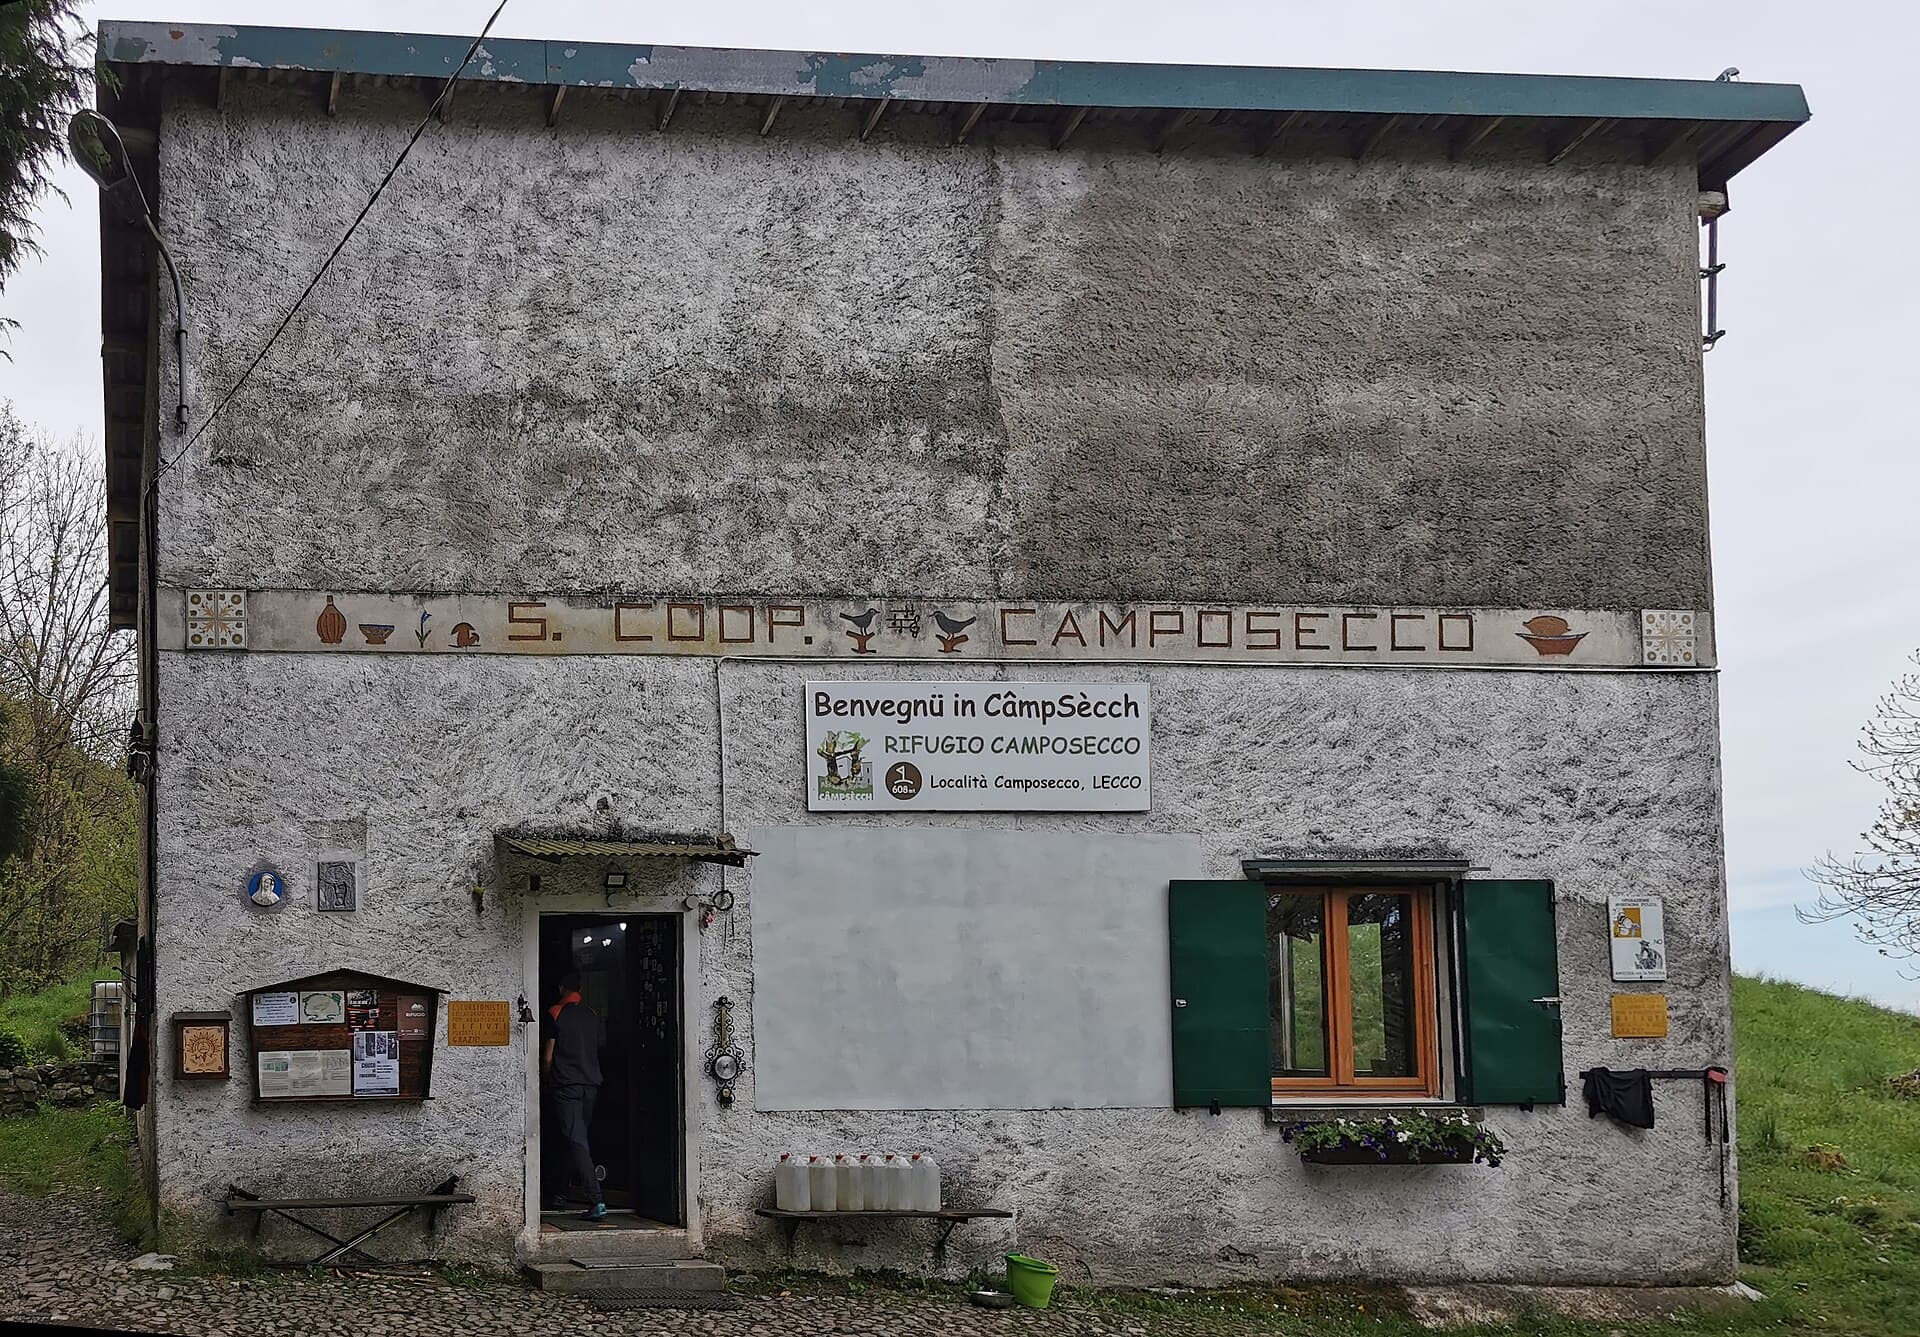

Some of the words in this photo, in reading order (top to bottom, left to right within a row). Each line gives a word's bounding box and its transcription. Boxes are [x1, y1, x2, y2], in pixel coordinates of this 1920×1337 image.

[508, 602, 562, 641] S.
[615, 603, 813, 645] COOP.
[1000, 608, 1475, 651] CAMPOSECCO
[814, 691, 945, 724] Benvegnü
[953, 693, 977, 718] in
[983, 691, 1140, 725] CâmpSècch
[884, 735, 985, 755] RIFUGIO
[991, 736, 1141, 755] CAMPOSECCO
[930, 774, 988, 790] Località
[994, 776, 1085, 791] Camposecco,
[1092, 775, 1142, 790] LECCO
